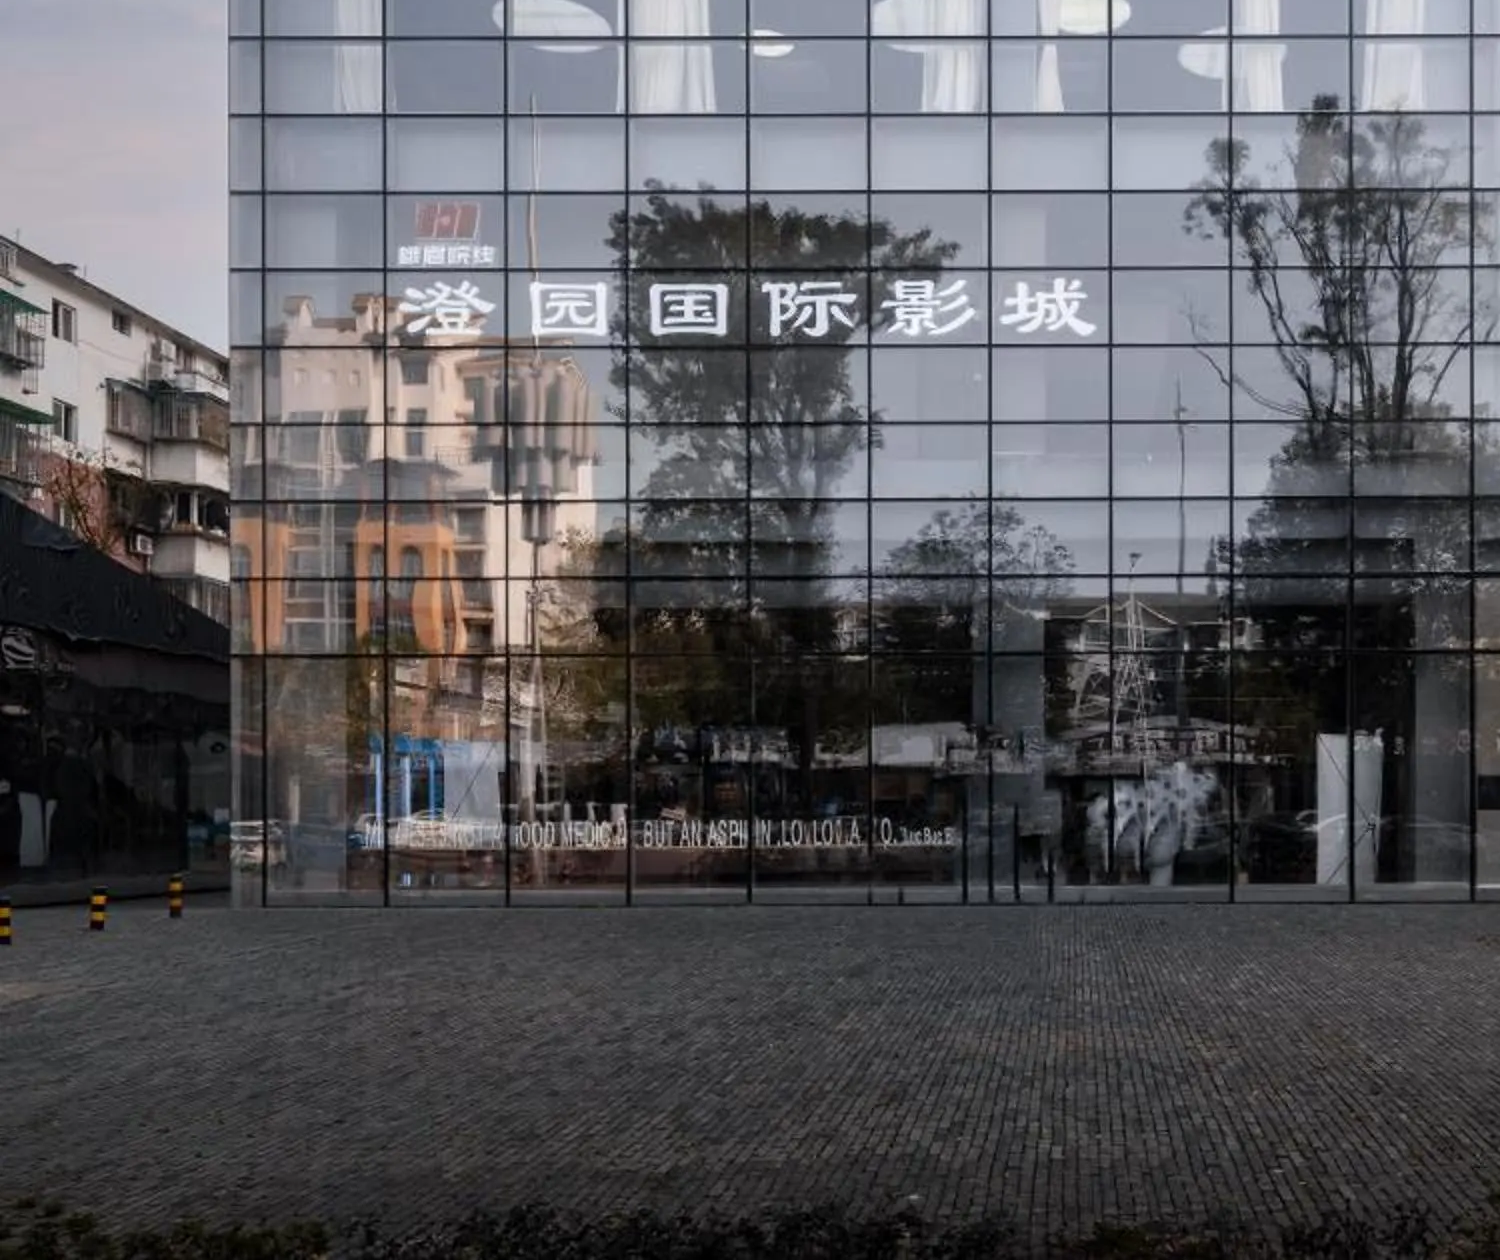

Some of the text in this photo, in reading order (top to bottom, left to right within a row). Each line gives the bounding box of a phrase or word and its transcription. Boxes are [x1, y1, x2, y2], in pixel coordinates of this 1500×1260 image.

[397, 278, 1098, 337] 澄园国际影城
[643, 820, 674, 848] BUT
[679, 820, 702, 848] AN
